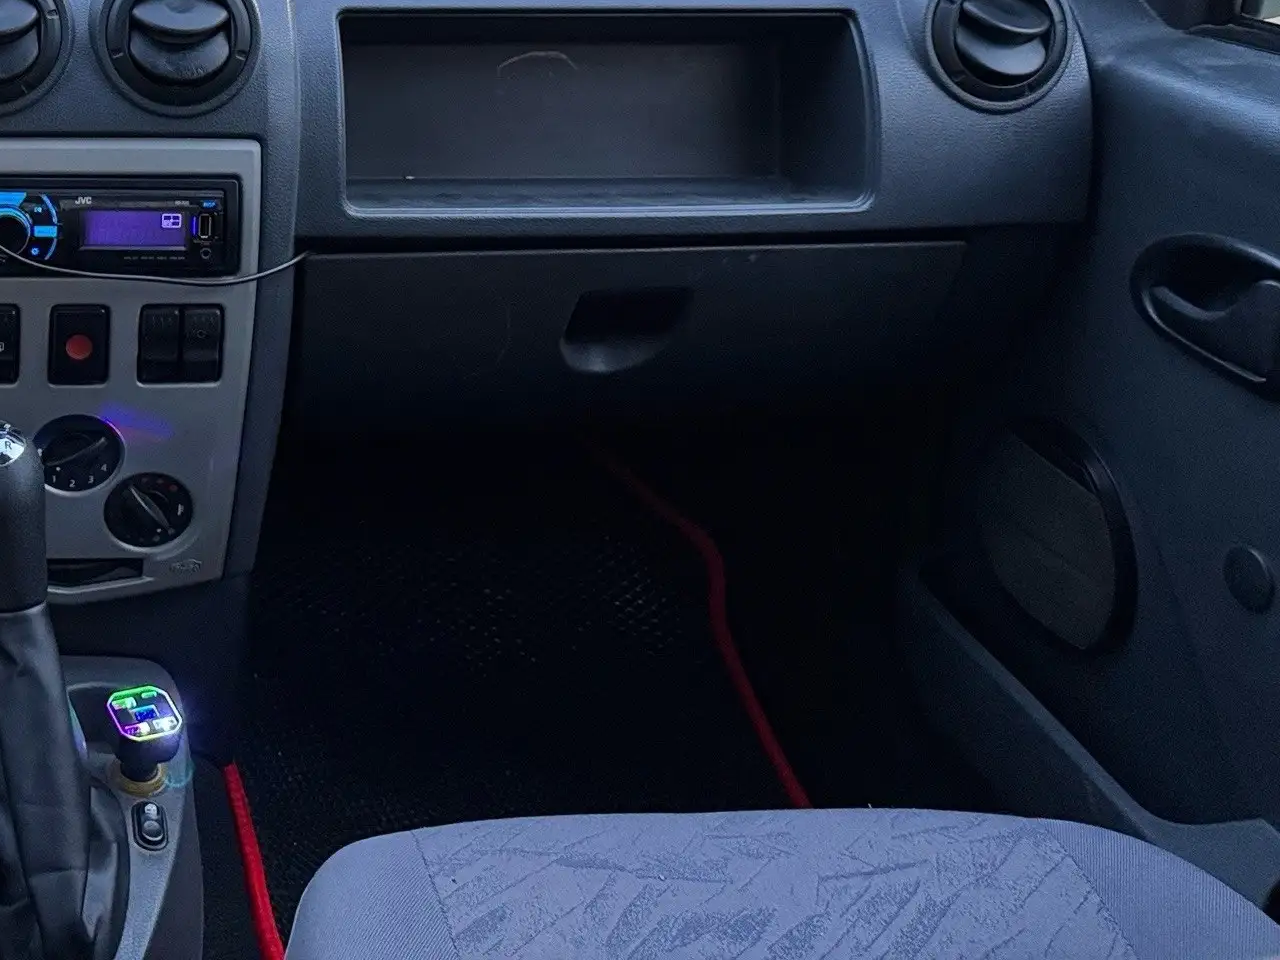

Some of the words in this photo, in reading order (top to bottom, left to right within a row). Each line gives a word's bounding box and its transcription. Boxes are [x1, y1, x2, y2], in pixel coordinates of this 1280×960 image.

[75, 196, 92, 205] JVC
[4, 440, 12, 450] R
[100, 463, 107, 472] 4
[51, 475, 57, 483] 1
[69, 479, 76, 488] 2
[87, 475, 95, 484] 3
